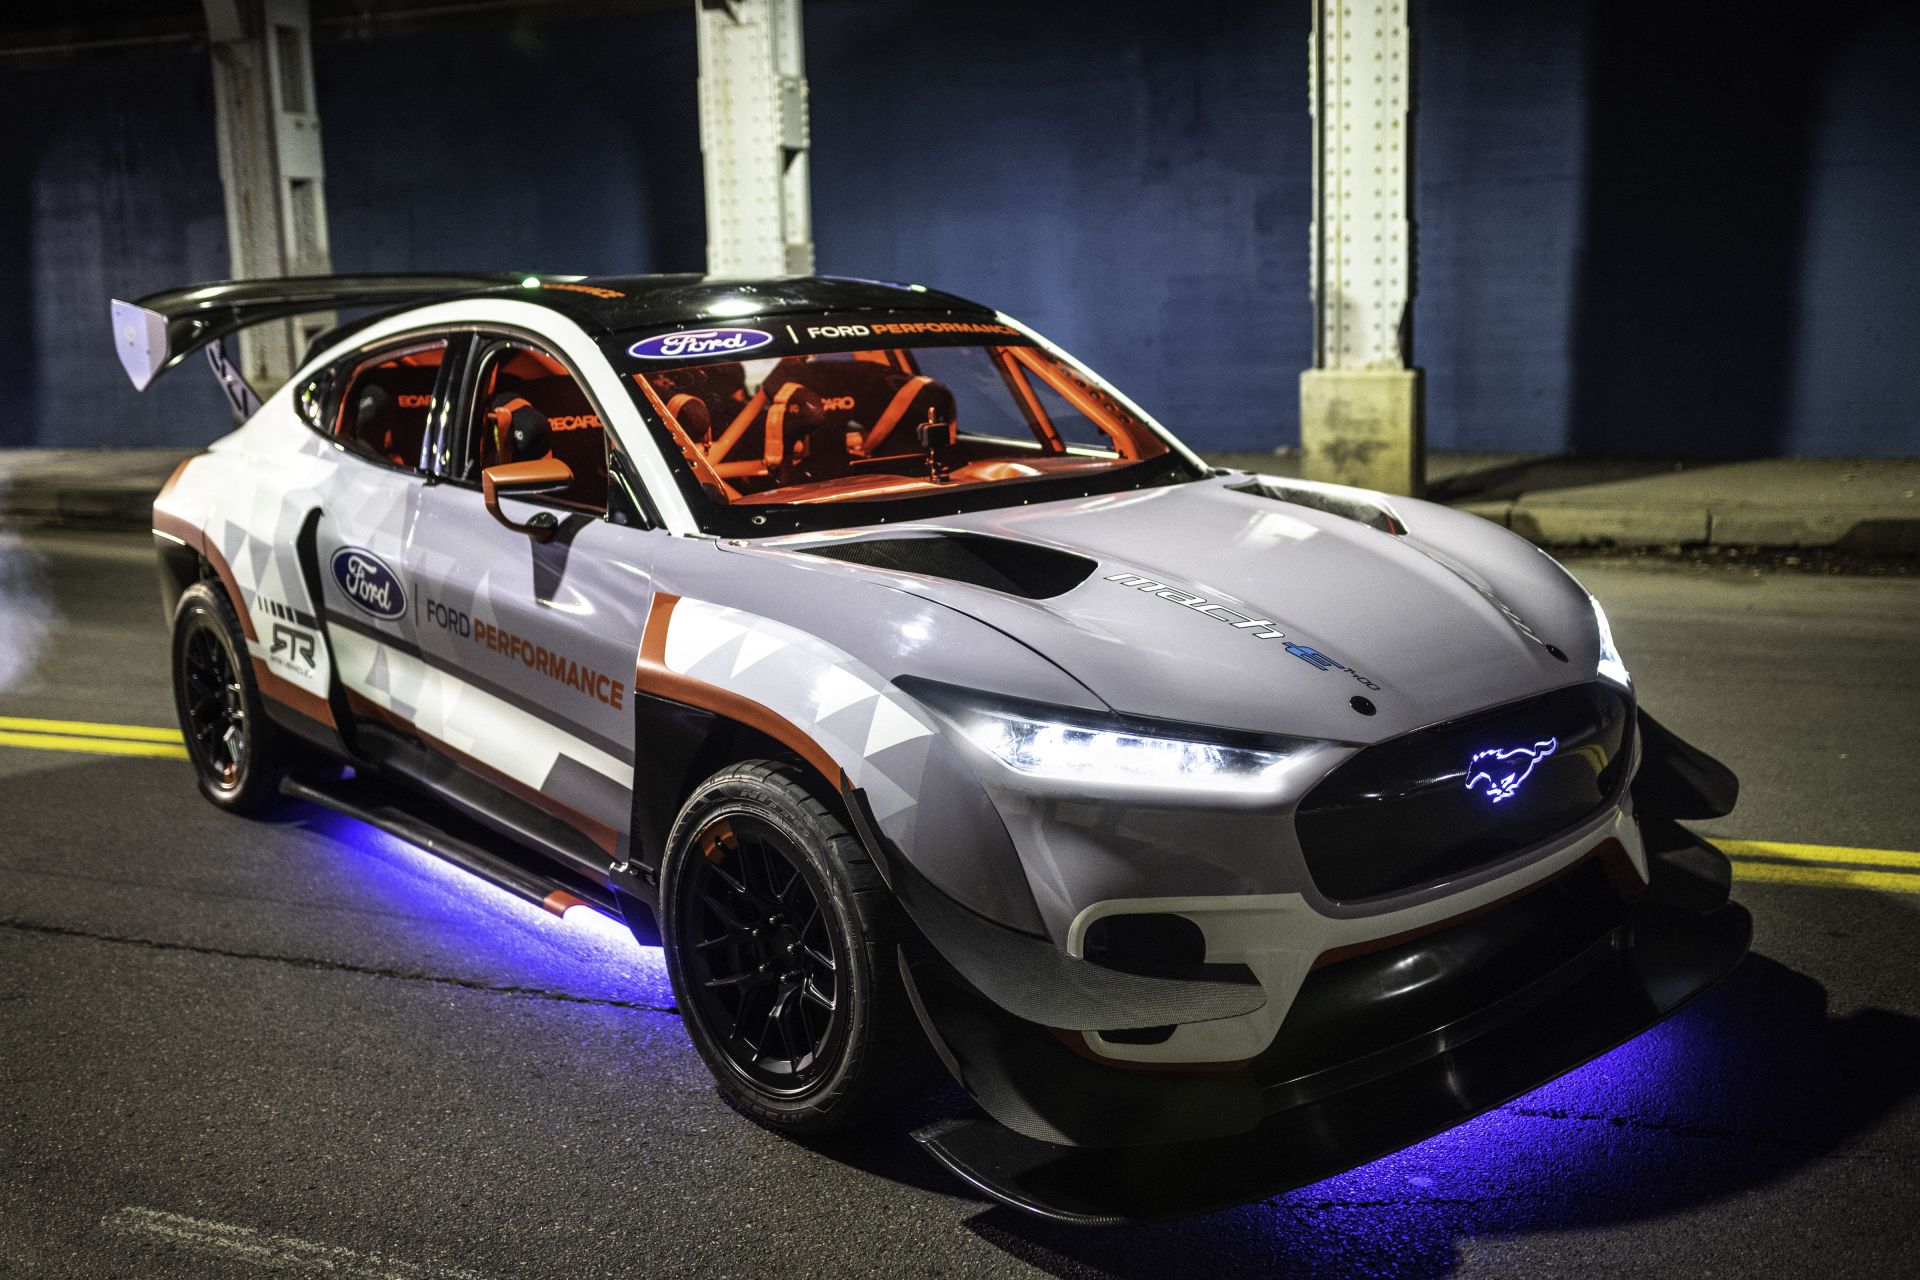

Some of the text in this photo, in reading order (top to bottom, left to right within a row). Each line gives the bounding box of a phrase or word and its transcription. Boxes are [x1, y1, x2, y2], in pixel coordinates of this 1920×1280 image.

[660, 331, 748, 355] Ford
[806, 324, 870, 339] FORD
[398, 394, 432, 408] ECAR
[346, 555, 392, 611] Ford
[270, 622, 316, 669] RTR
[427, 599, 625, 710] FORD PERFORMANCE
